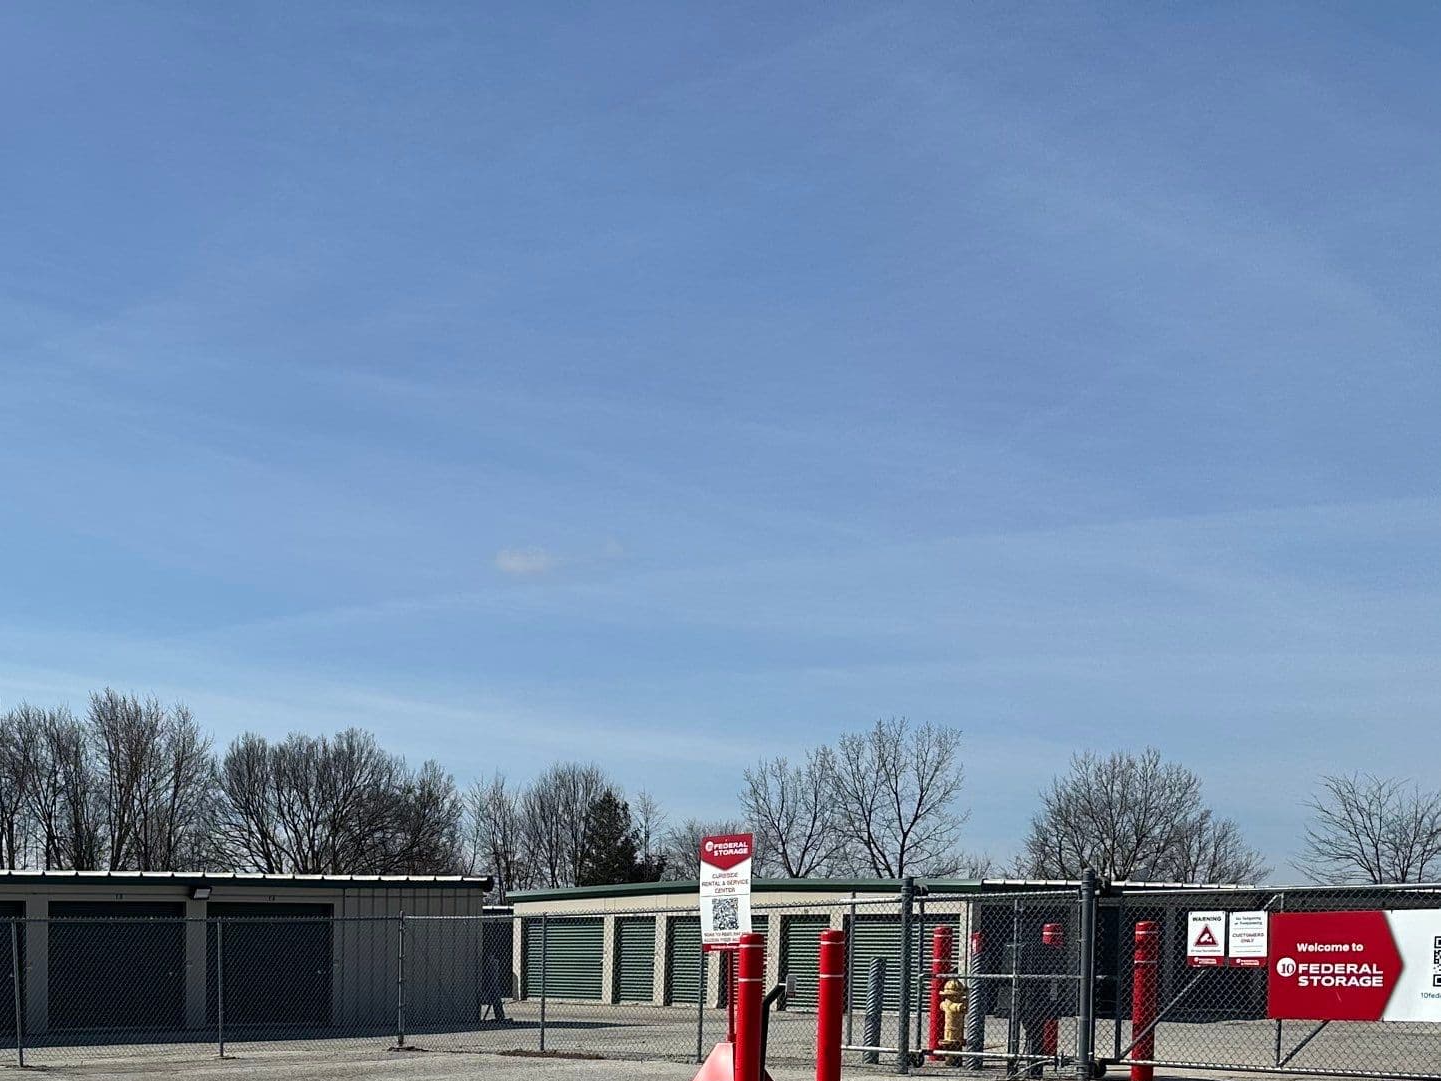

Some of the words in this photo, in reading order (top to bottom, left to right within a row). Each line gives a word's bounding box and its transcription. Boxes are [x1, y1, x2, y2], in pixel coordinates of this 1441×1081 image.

[713, 841, 749, 850] FEDERAL
[713, 848, 749, 857] STORAGE
[1297, 943, 1350, 952] Welcome
[1352, 943, 1364, 952] to
[1298, 963, 1384, 974] FEDERAL
[1298, 976, 1384, 987] STORAGE
